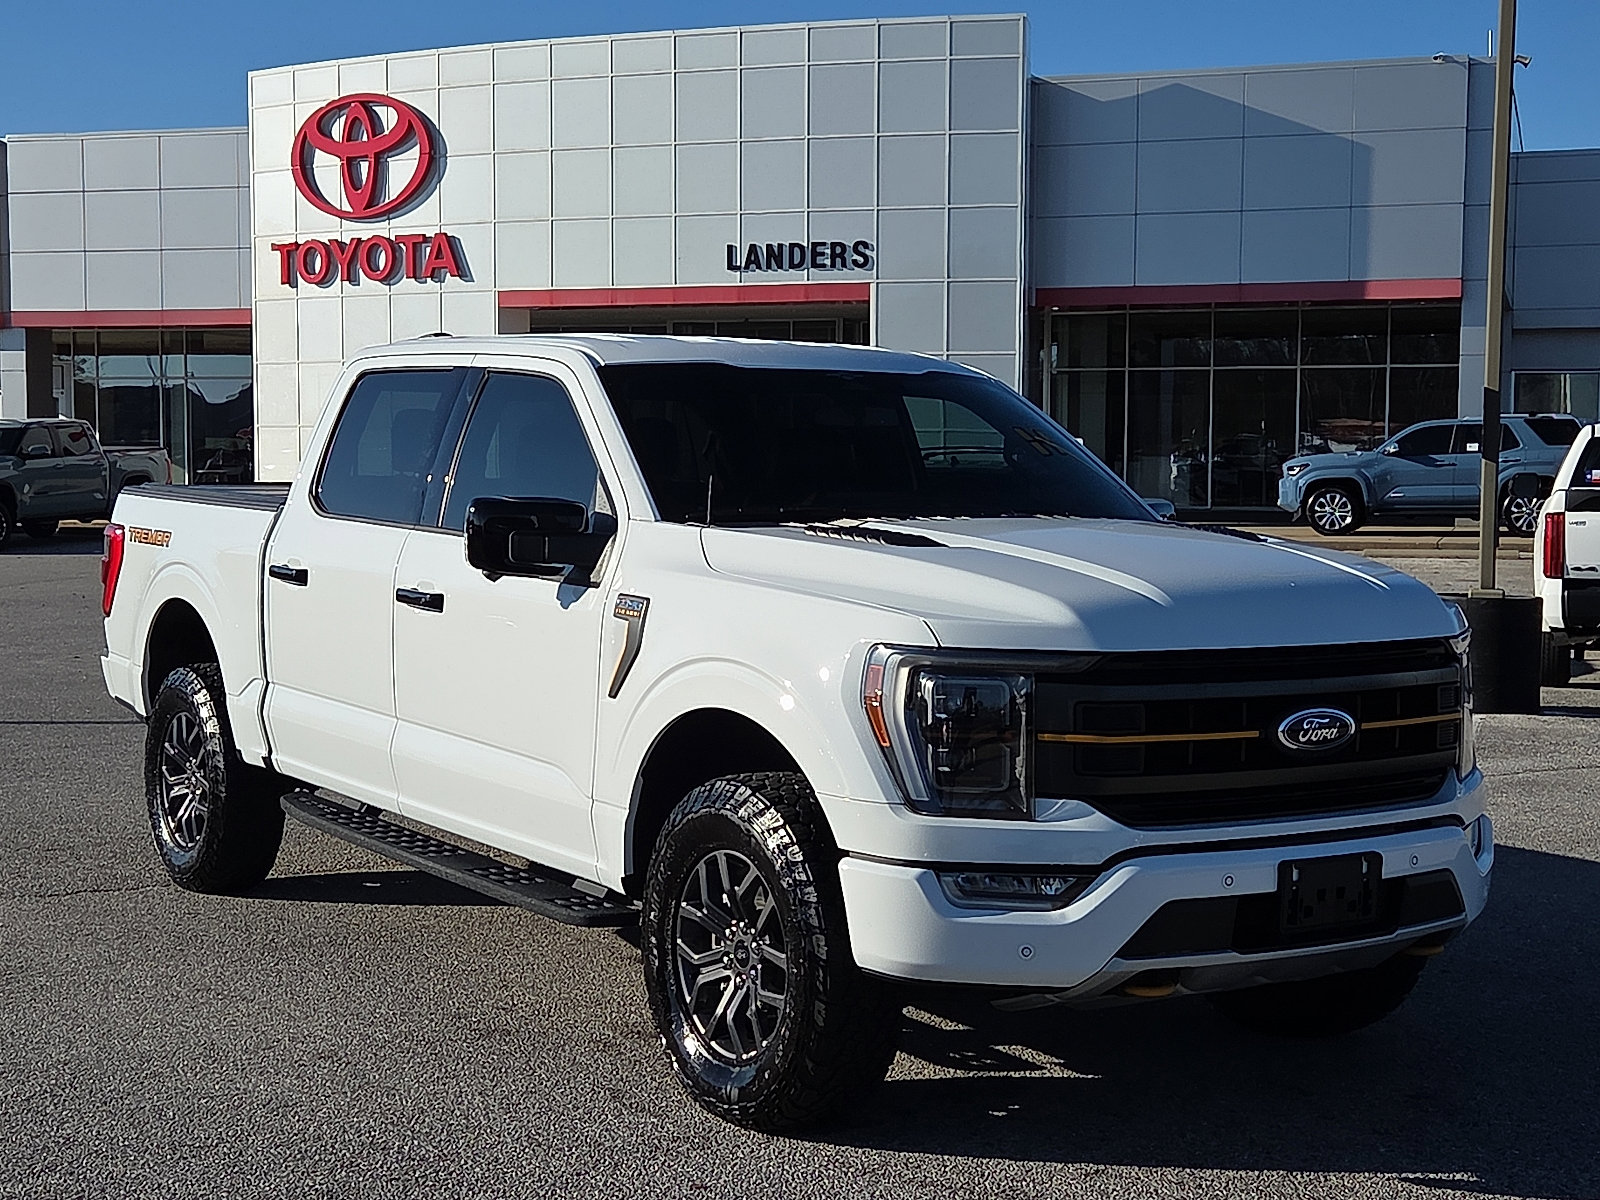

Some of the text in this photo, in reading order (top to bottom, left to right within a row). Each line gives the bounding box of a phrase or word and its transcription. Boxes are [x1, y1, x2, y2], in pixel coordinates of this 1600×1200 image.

[271, 232, 460, 286] TOYOTA
[726, 240, 873, 271] LANDERS
[128, 526, 172, 548] TREMOR
[1298, 718, 1341, 742] Ford
